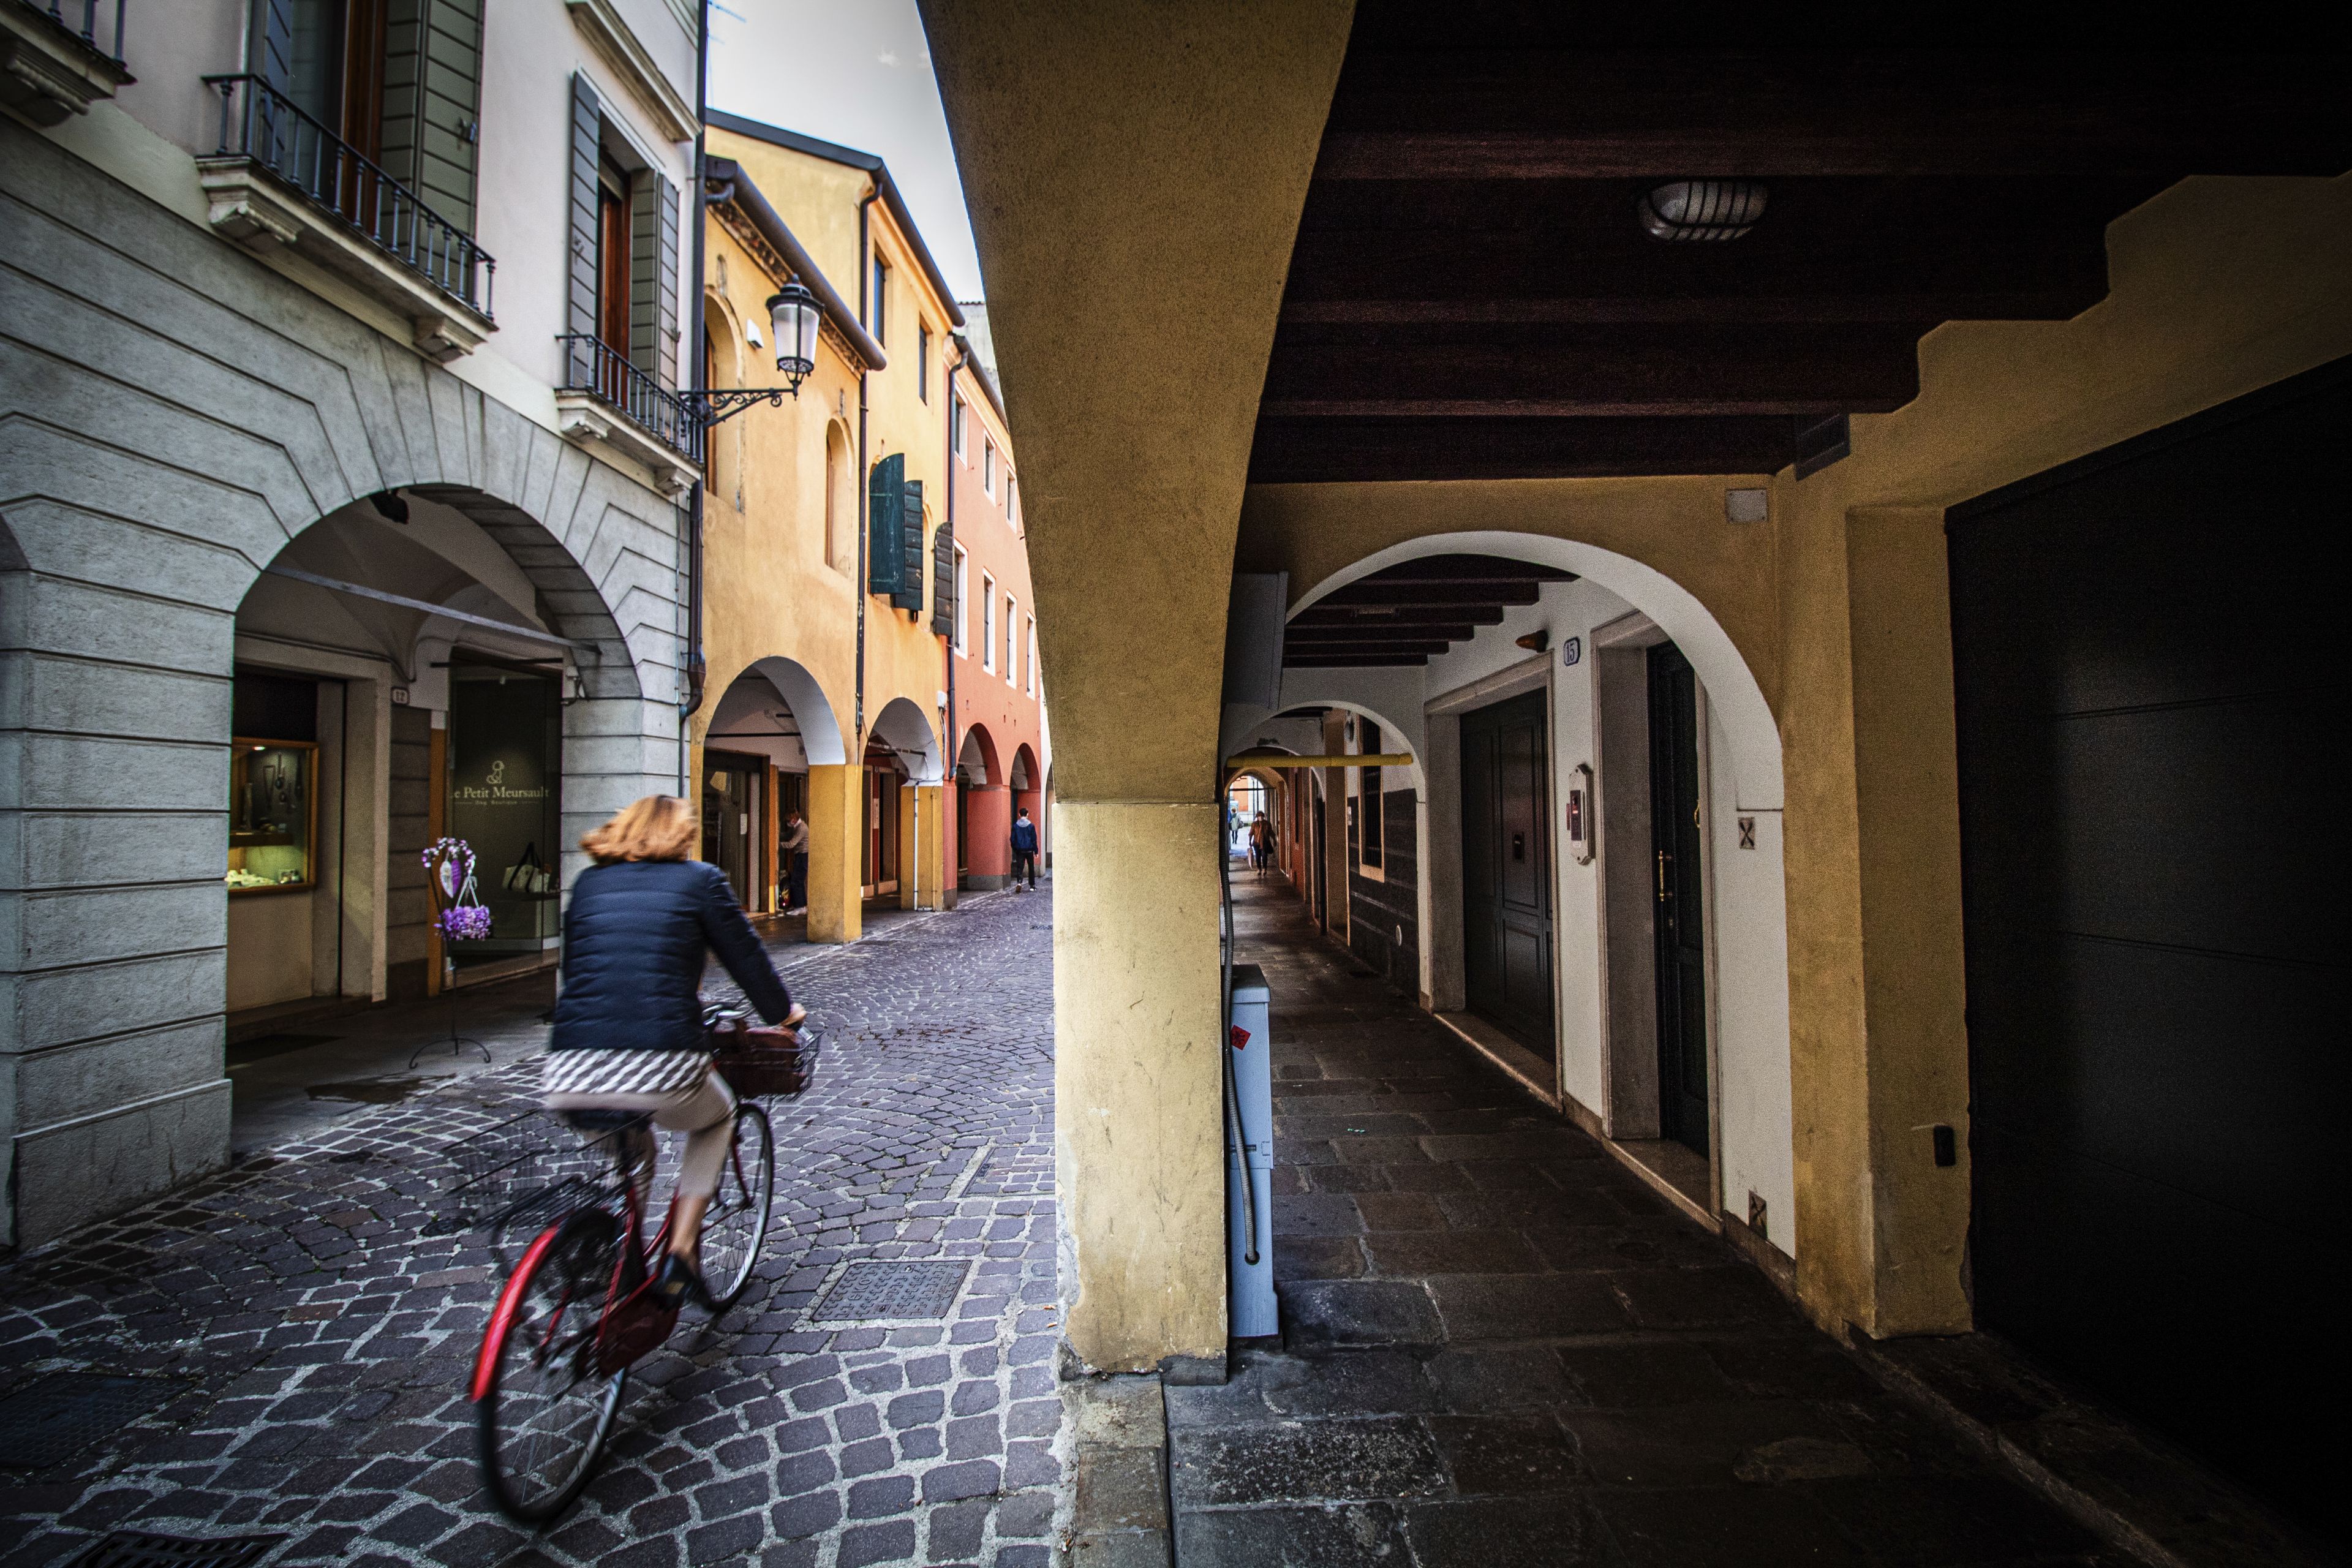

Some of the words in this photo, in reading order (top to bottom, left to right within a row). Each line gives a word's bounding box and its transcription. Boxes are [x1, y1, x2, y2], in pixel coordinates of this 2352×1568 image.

[1567, 643, 1575, 662] 15
[464, 786, 490, 798] Petit
[492, 786, 549, 798] Meursault
